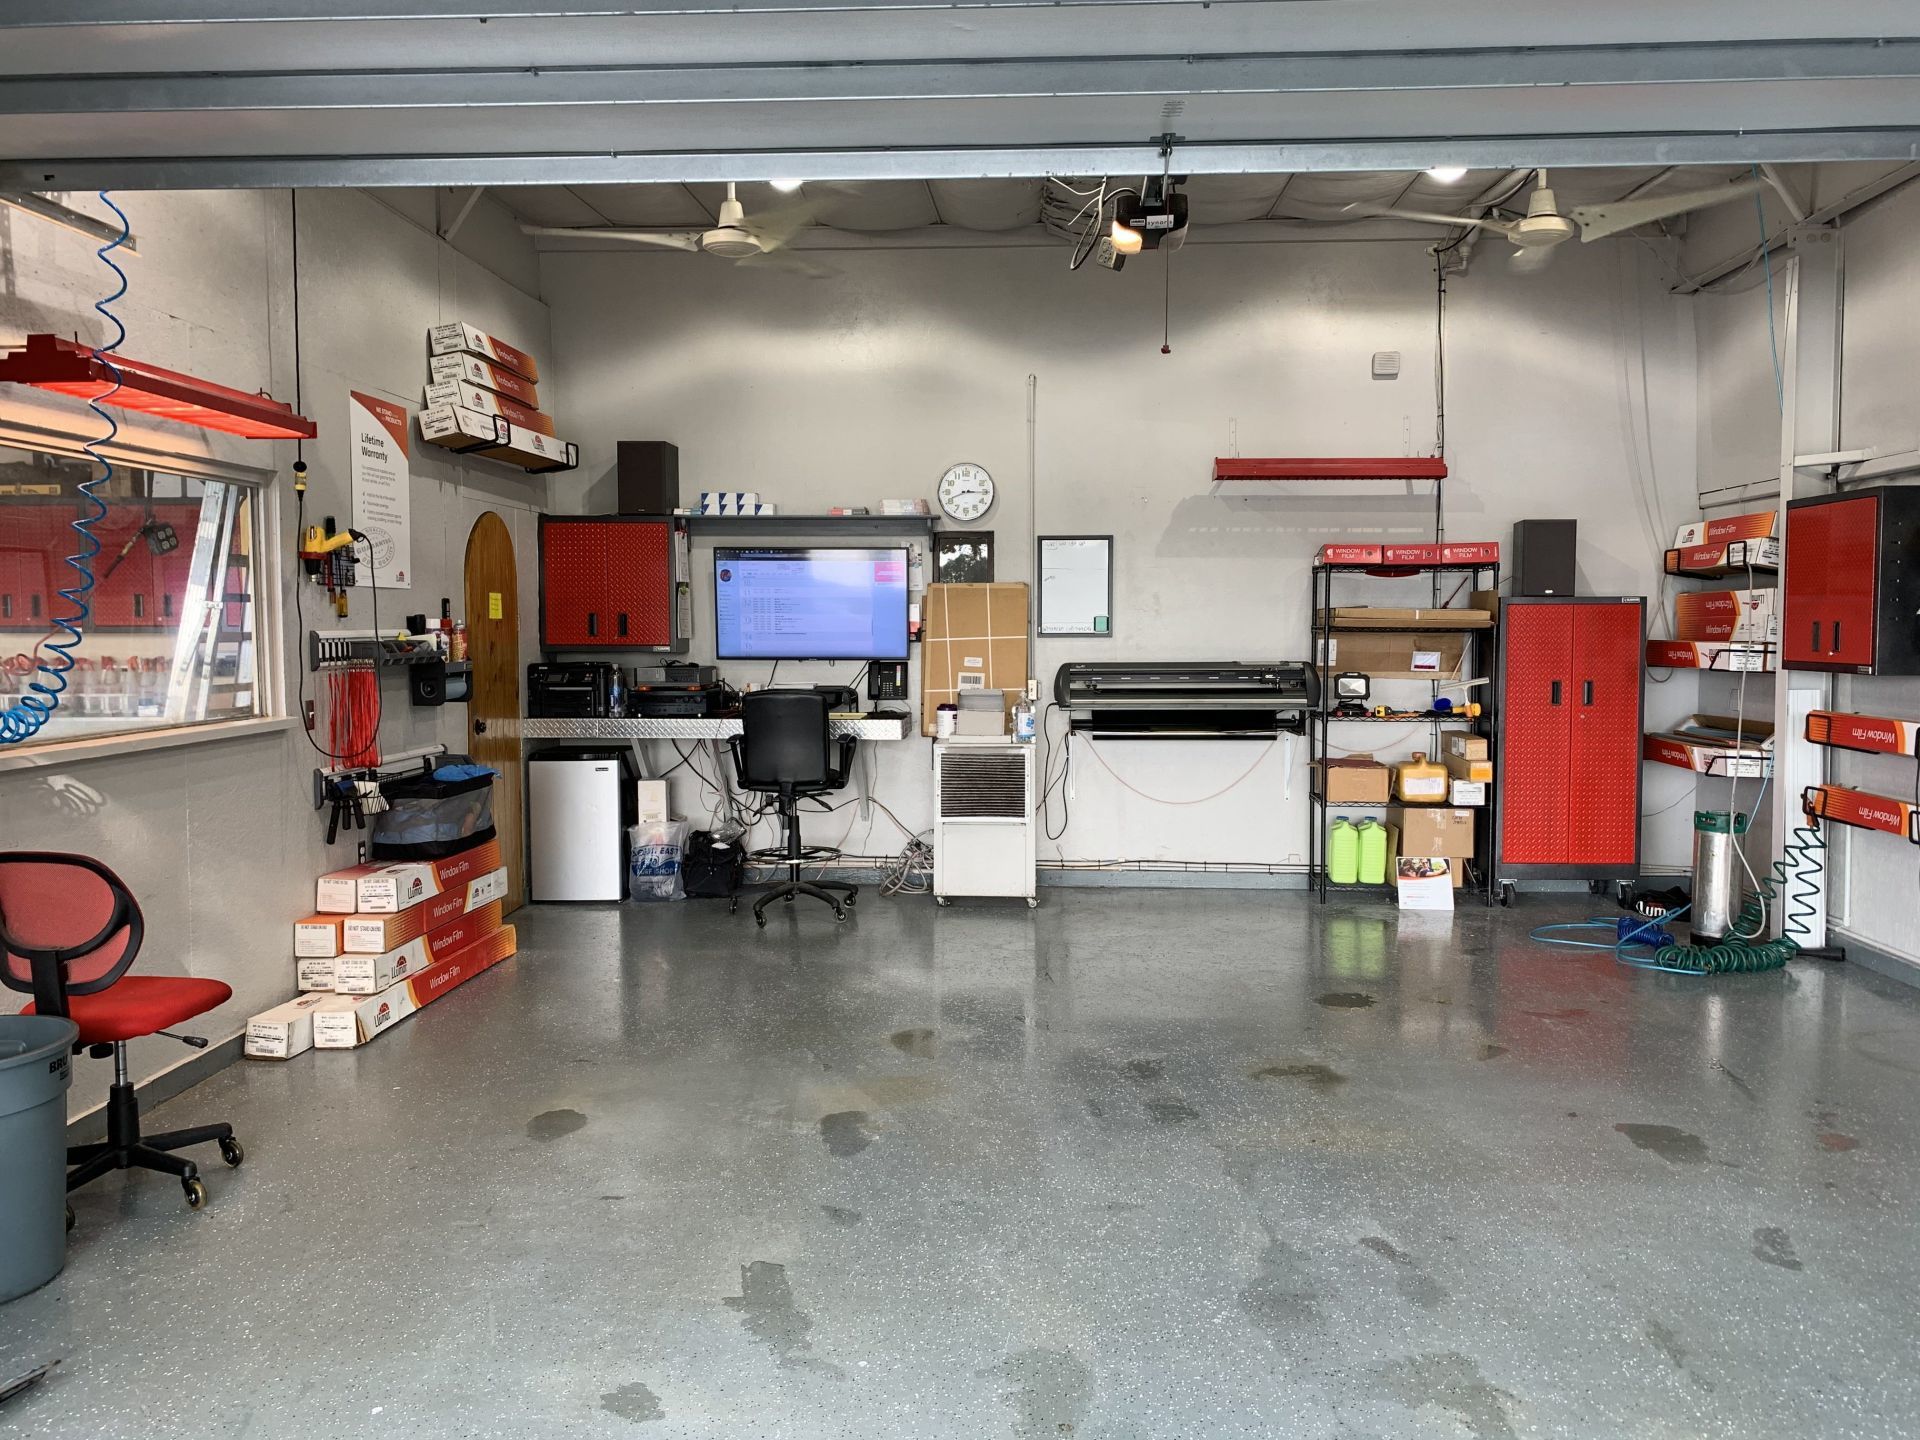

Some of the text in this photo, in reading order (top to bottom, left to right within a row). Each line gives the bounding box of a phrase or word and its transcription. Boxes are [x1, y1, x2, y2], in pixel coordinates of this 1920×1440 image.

[361, 432, 384, 448] Lifetime
[361, 446, 388, 464] Warranty
[1709, 525, 1736, 536] Window Film
[1694, 552, 1710, 560] Window
[1677, 651, 1694, 660] Window
[1852, 728, 1894, 743] Window Film
[1662, 749, 1688, 761] Window Film
[1859, 806, 1900, 826] Window Film
[440, 861, 469, 880] Window Film
[433, 898, 463, 918] Window Film
[432, 930, 463, 951] Window Film
[430, 966, 460, 989] Window Film
